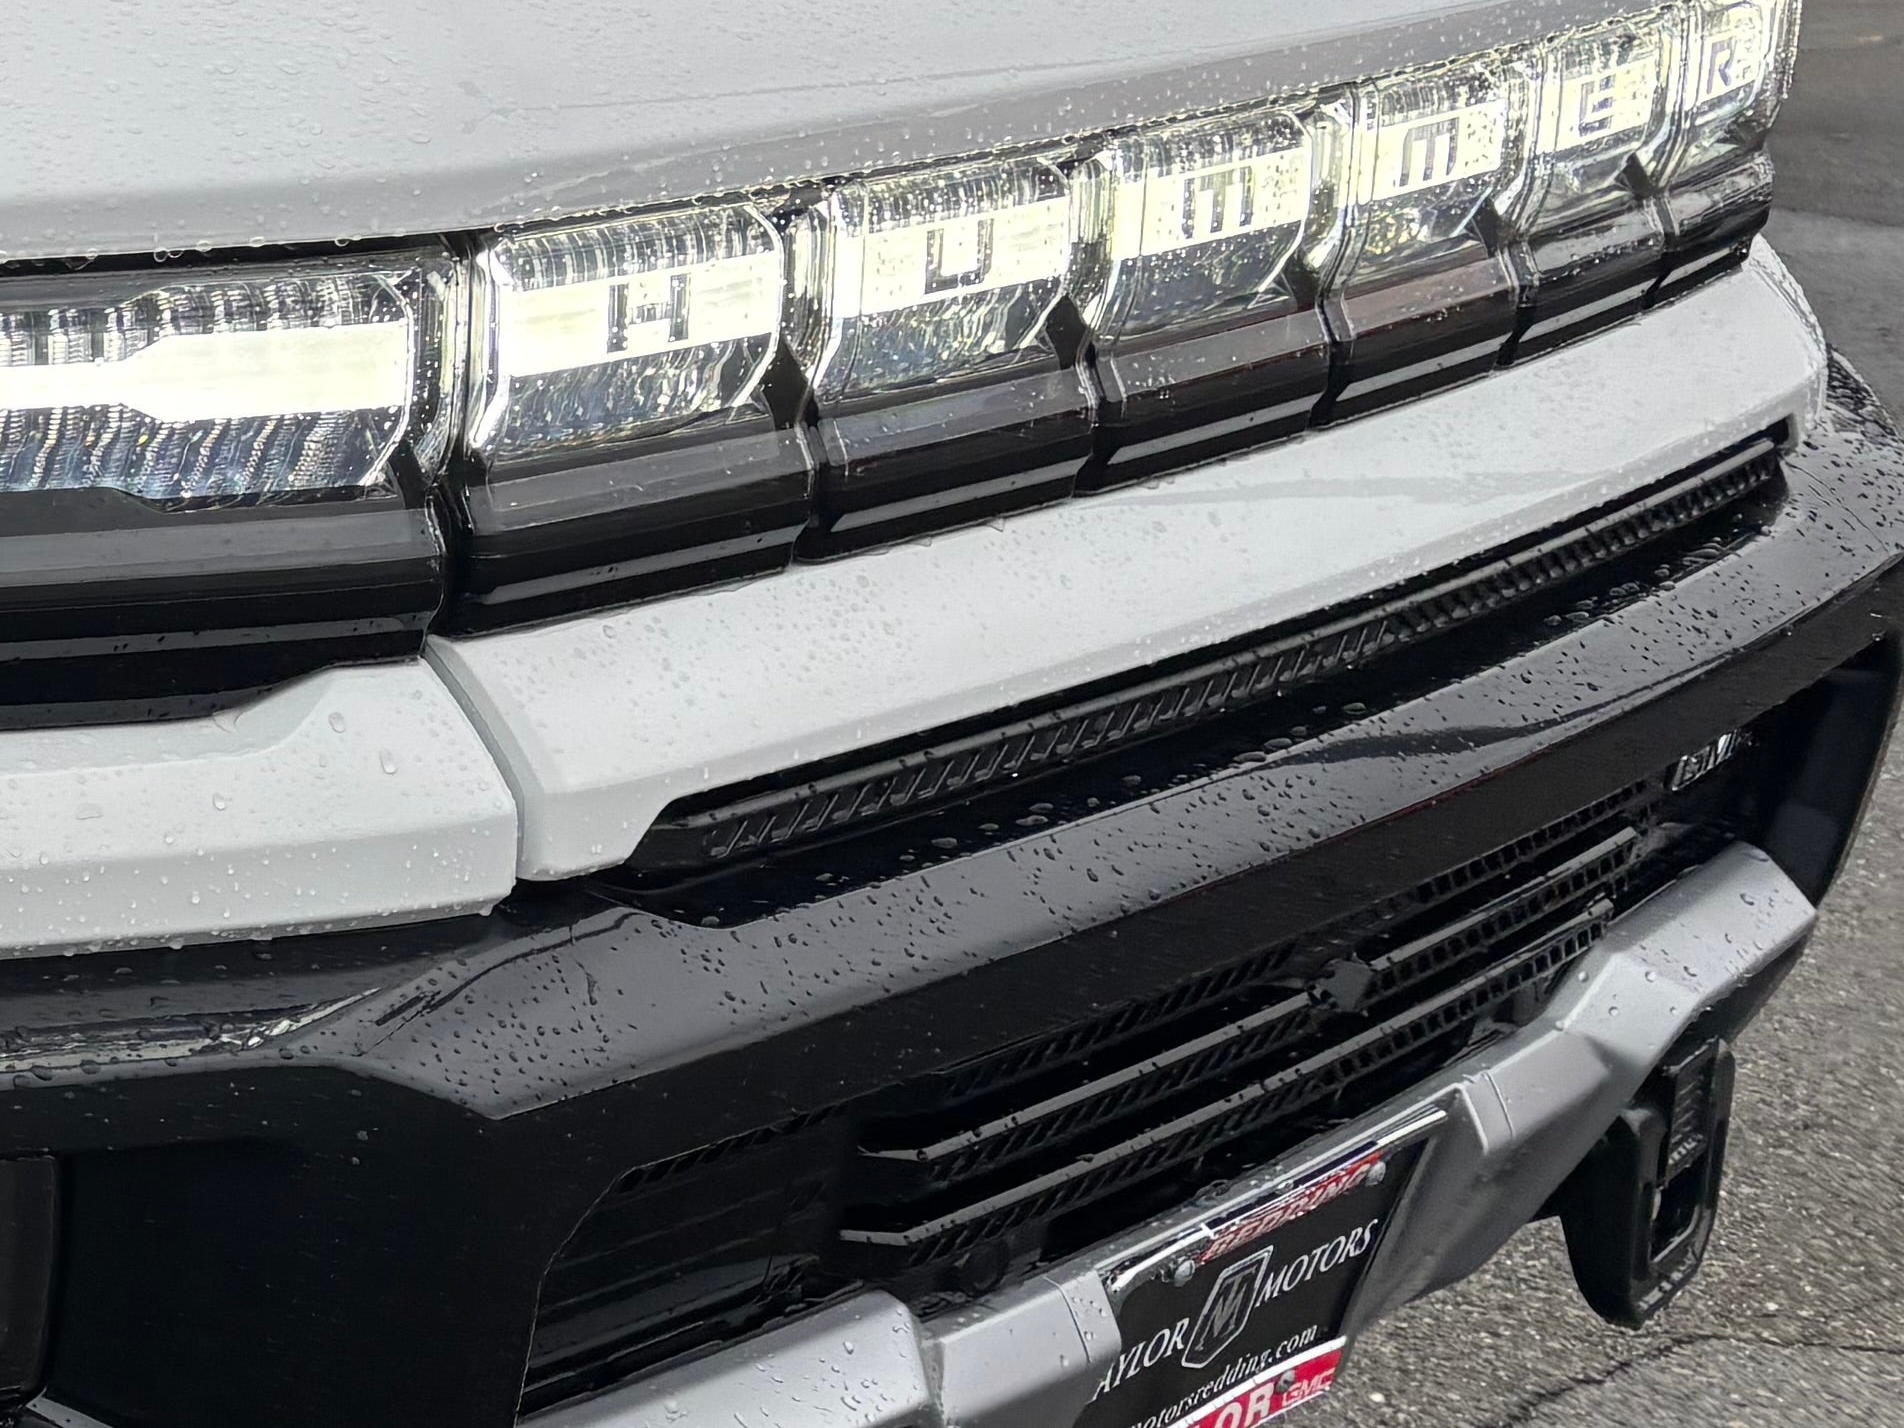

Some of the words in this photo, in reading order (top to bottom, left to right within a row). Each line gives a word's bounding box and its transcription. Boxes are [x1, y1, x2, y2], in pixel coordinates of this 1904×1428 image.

[1092, 1317, 1190, 1402] AYLOR
[1254, 1218, 1378, 1308] MOTORS
[1281, 1367, 1336, 1407] GMC
